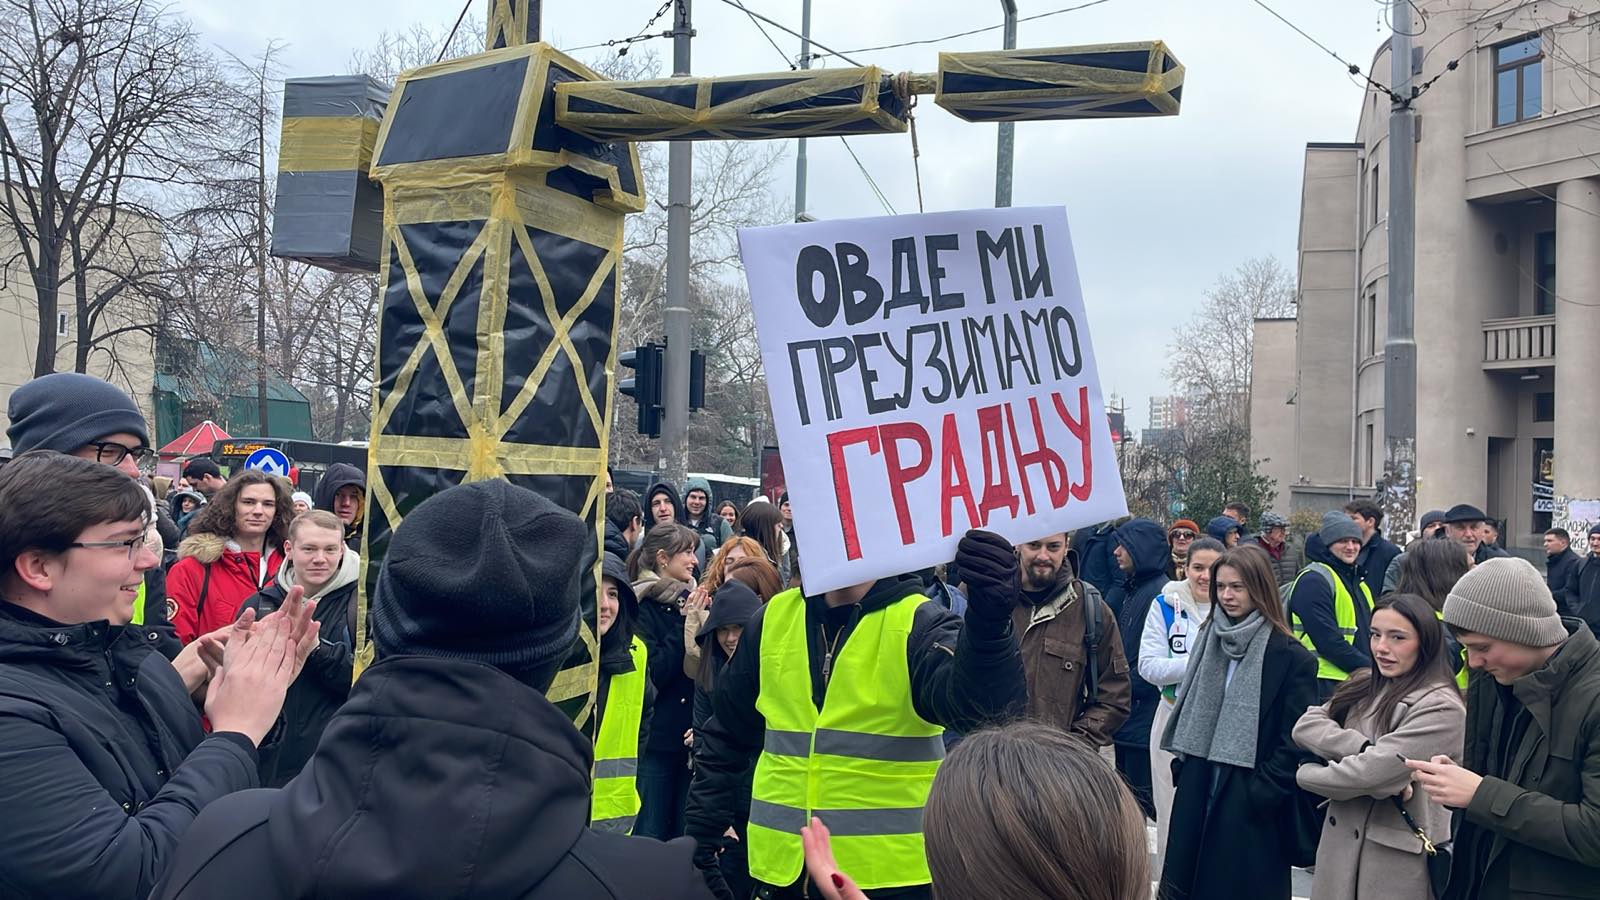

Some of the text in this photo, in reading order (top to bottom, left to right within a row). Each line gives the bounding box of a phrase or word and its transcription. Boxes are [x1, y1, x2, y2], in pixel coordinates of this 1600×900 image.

[797, 225, 1054, 328] ОВДЕ МИ
[787, 305, 1083, 426] ПРЕУЗИМАМО
[827, 386, 1093, 561] ГРАДЊУ
